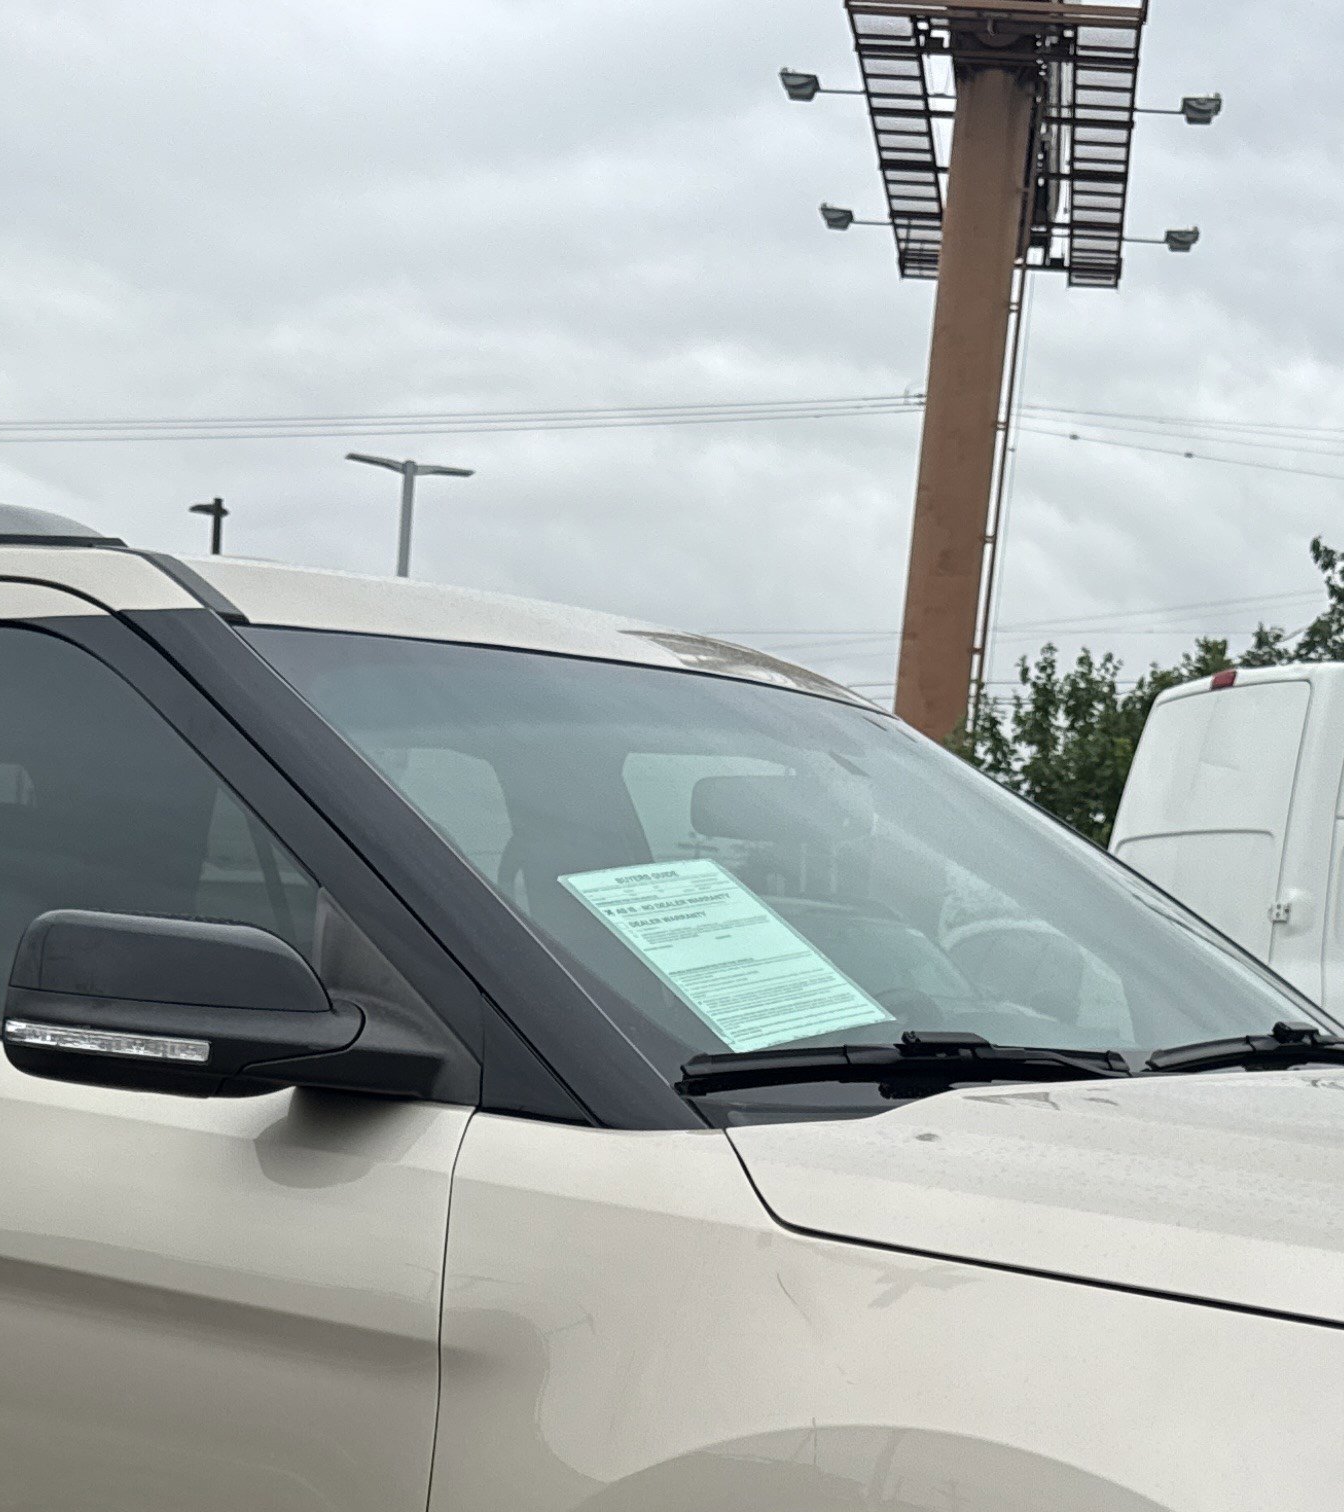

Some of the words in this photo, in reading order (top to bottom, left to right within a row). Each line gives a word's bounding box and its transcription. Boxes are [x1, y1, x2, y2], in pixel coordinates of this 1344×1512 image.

[615, 873, 651, 885] BUYERS
[652, 870, 679, 881] GUIDE
[655, 898, 687, 911] DEALER
[688, 892, 731, 905] WARRANTY
[628, 917, 660, 929] DEALER
[661, 911, 706, 924] WARRANTY
